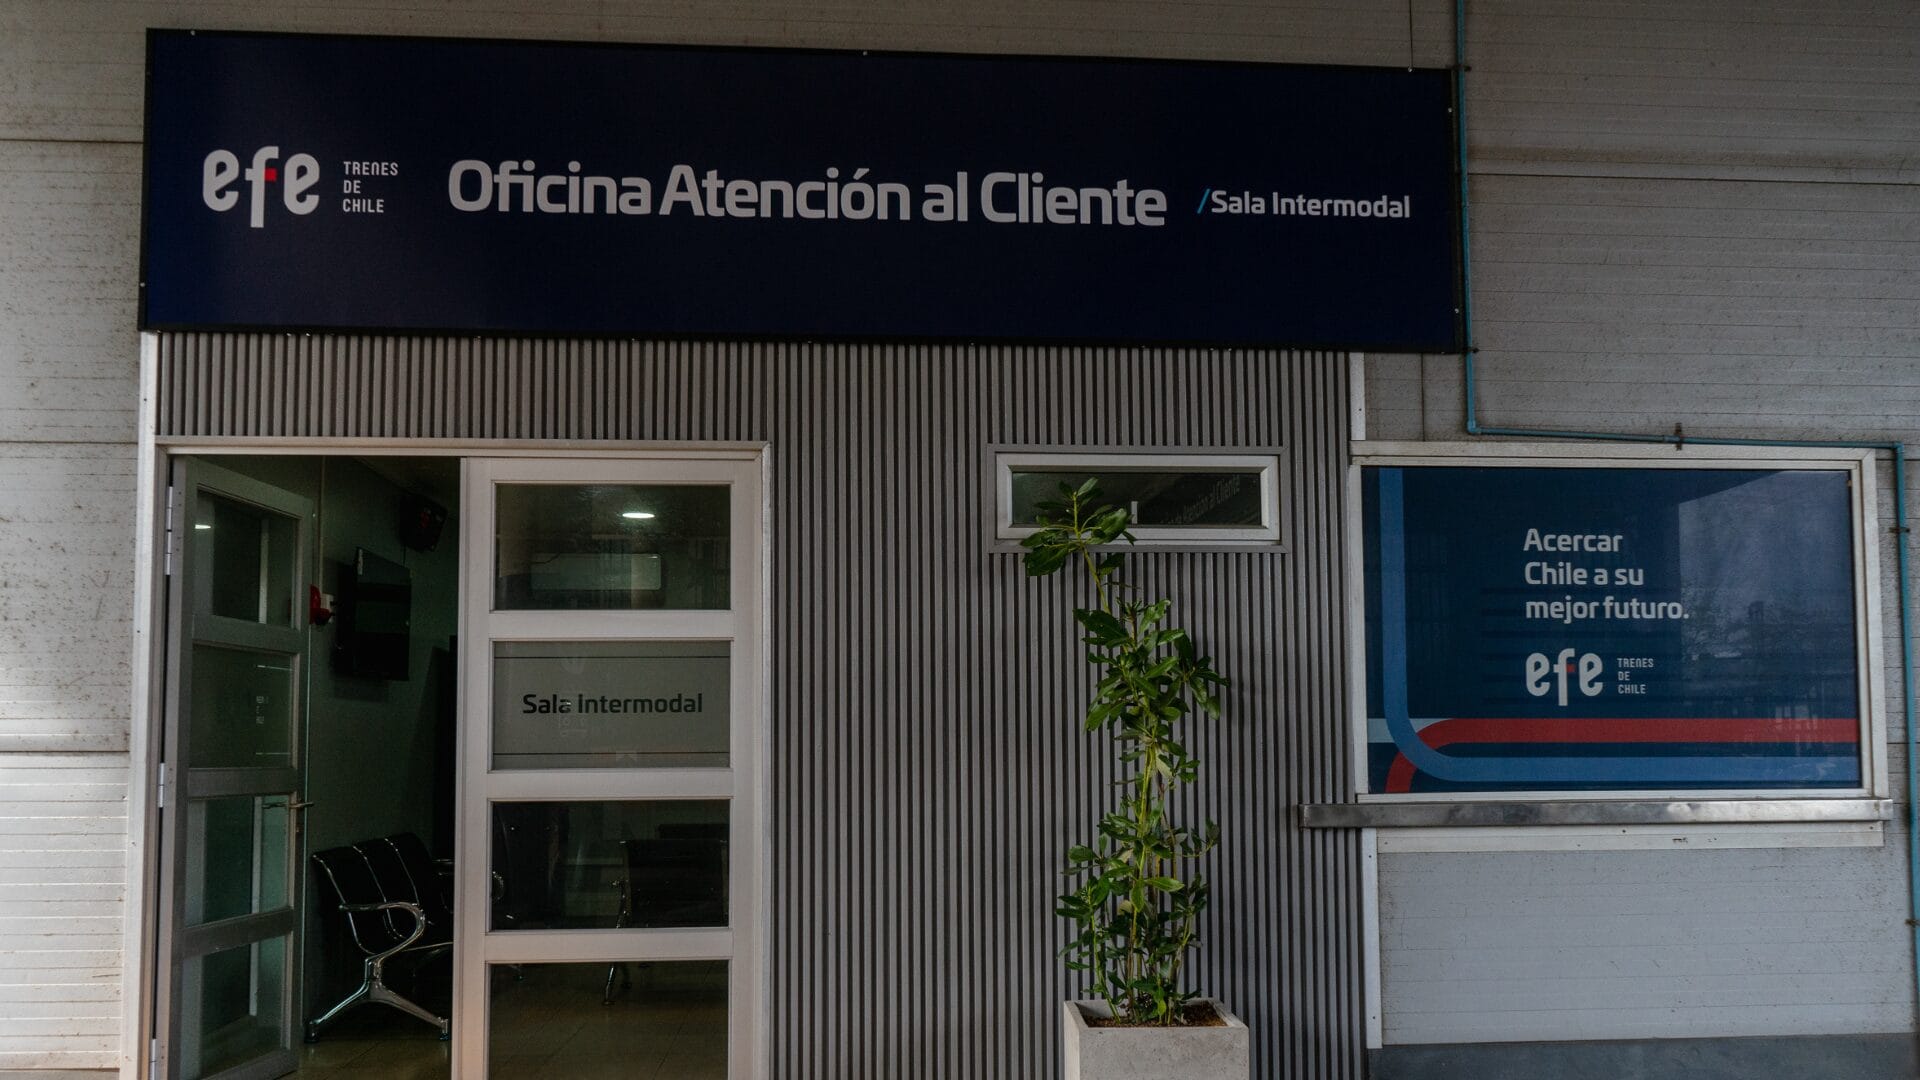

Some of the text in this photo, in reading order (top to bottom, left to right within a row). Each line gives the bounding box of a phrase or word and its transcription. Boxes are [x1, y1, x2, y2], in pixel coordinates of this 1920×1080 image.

[343, 161, 399, 176] TRENES
[203, 146, 320, 228] efe
[343, 179, 362, 194] DE
[448, 159, 1168, 227] Oficina Atención al Cliente
[342, 198, 385, 214] CHILE
[1272, 192, 1411, 219] Intermodal
[1523, 528, 1624, 552] Acercar
[1524, 561, 1644, 586] Chile a su
[1525, 595, 1691, 624] mejor futuro.
[1616, 657, 1655, 668] TRENES
[1525, 648, 1604, 706] efe
[1617, 670, 1631, 681] DE
[1617, 684, 1647, 695] CHILE
[522, 693, 704, 715] Sala Intermodal
